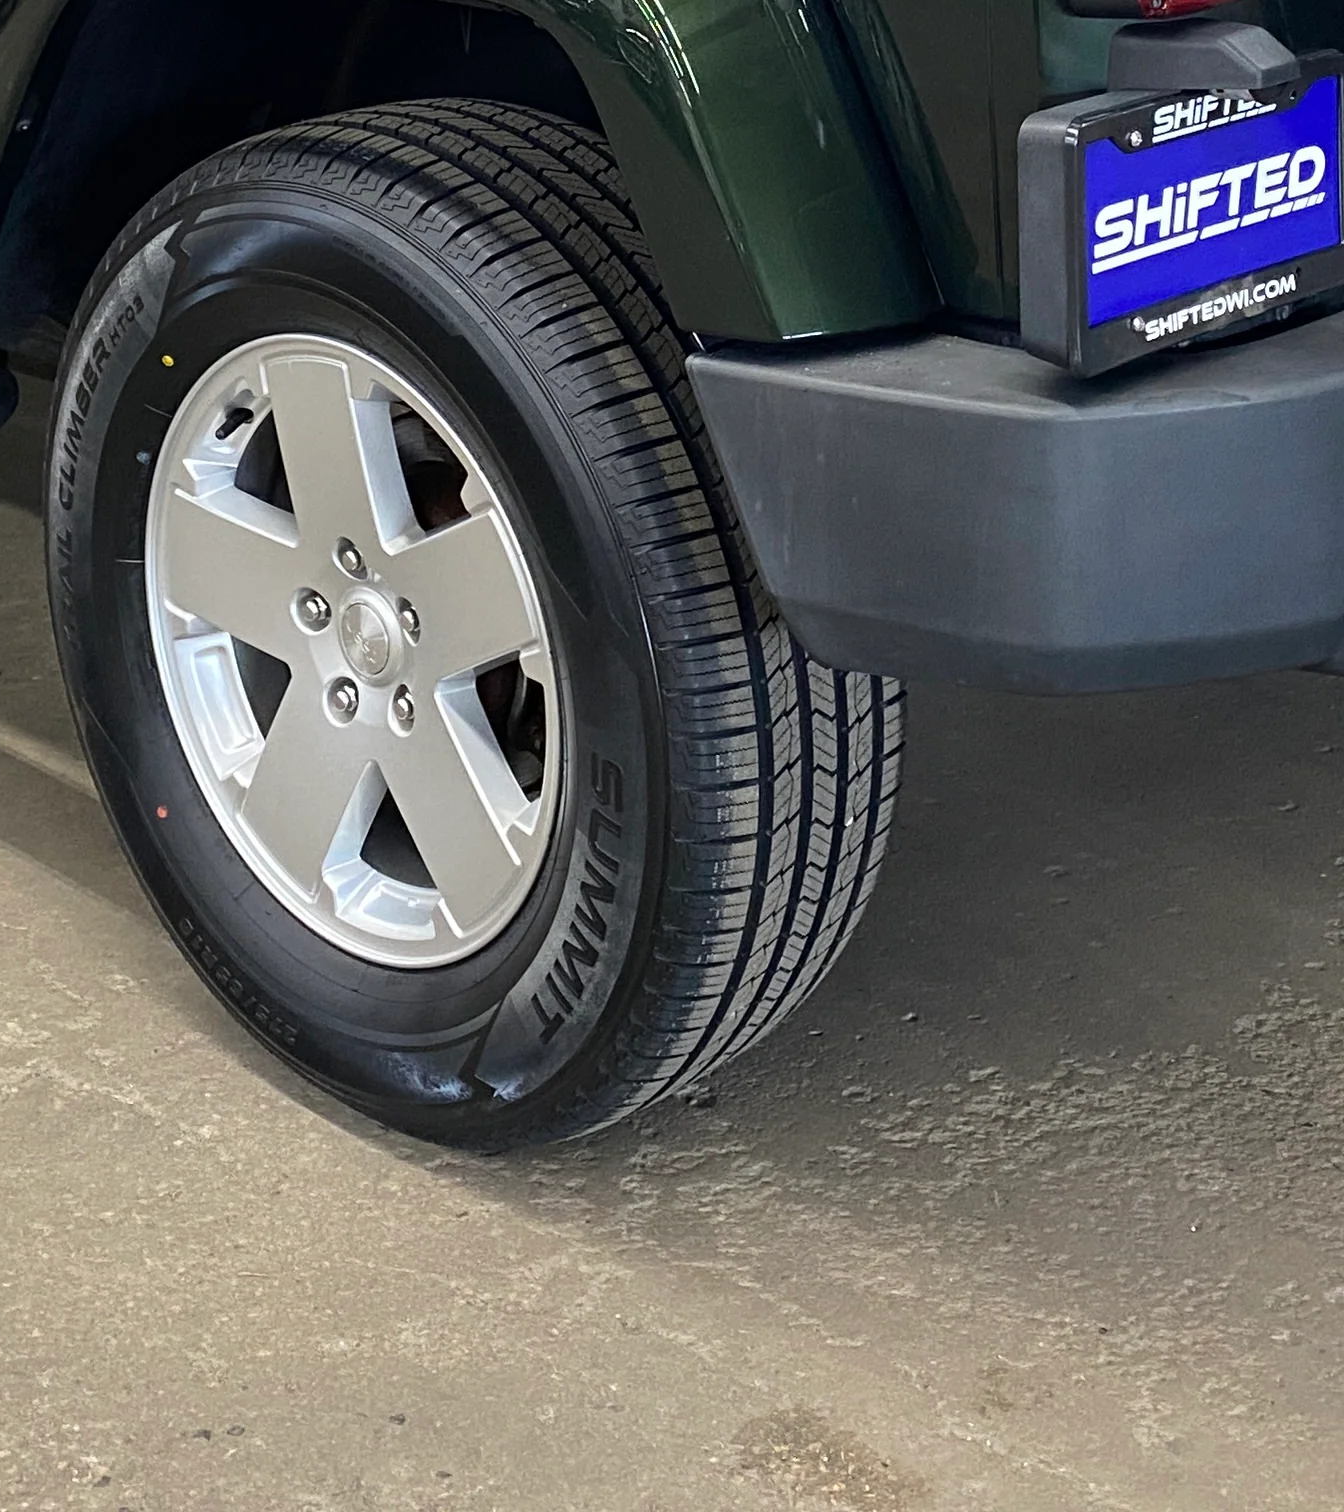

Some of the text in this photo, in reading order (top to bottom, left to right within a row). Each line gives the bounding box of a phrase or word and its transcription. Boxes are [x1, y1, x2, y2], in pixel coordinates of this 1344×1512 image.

[1144, 273, 1297, 341] SHIFTEDWI.COM
[58, 337, 112, 511] CLIMBER
[530, 752, 625, 1045] SUMMIT
